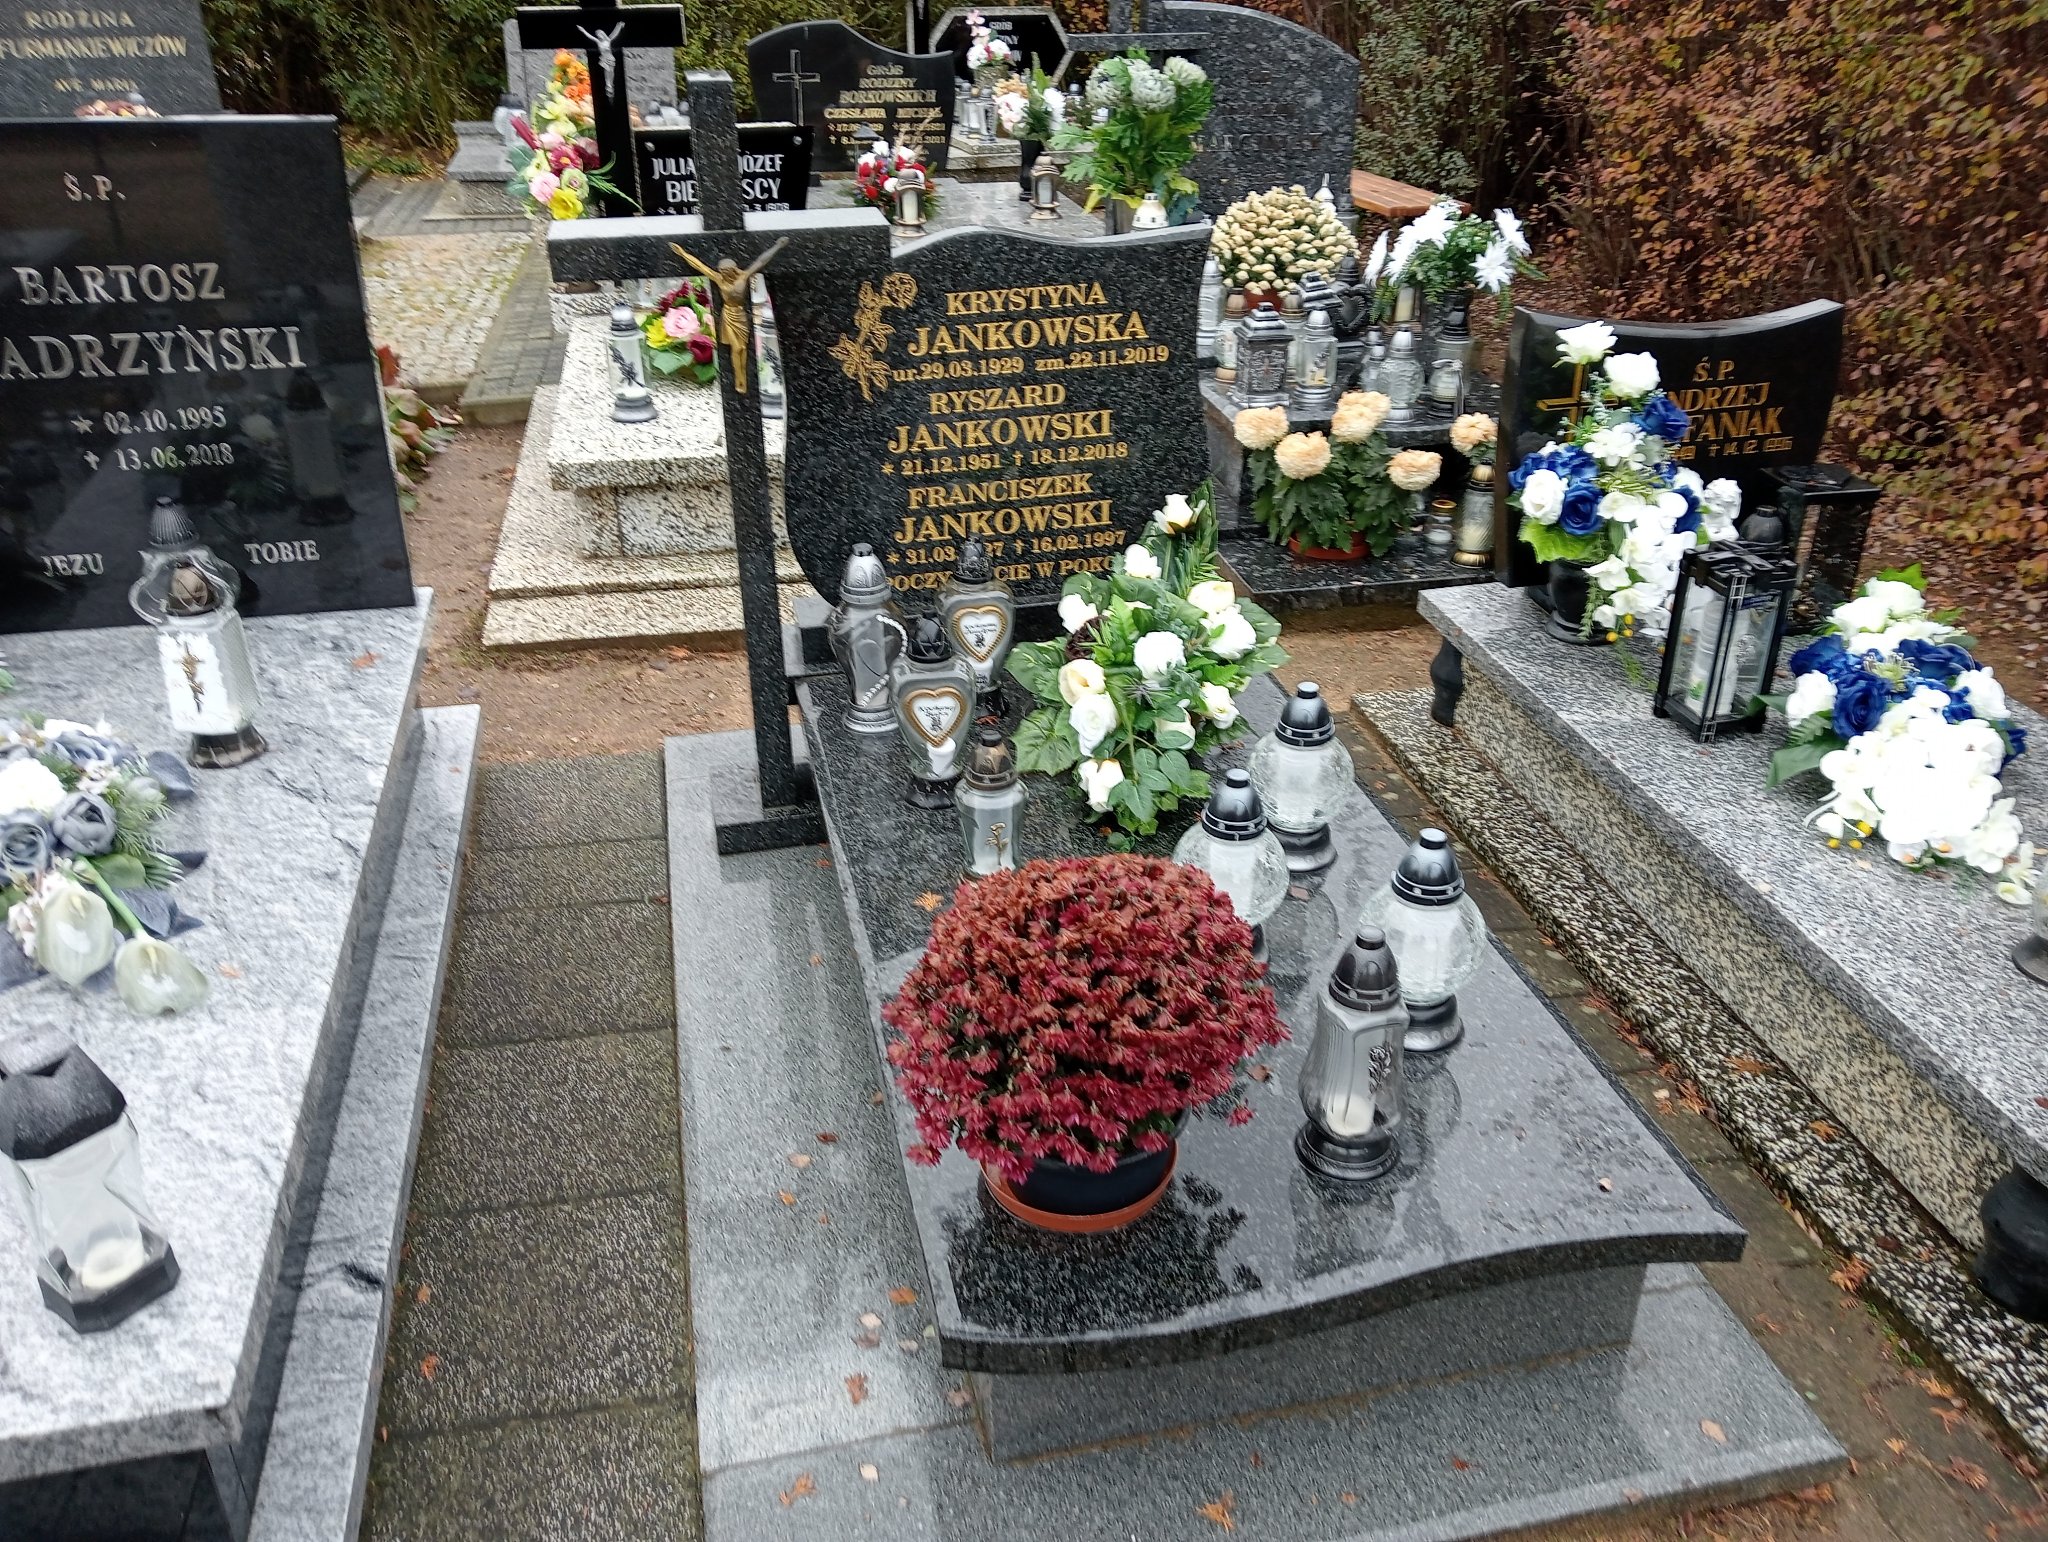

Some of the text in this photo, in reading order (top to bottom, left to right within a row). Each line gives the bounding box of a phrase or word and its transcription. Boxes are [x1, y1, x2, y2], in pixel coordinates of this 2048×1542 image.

[839, 89, 937, 103] BORKOWSKICH
[858, 77, 917, 89] RODZINY
[12, 262, 226, 306] BARTOSZ
[945, 282, 1108, 316] KRYSTYNA
[907, 311, 1150, 357] JANKOWSKA
[1034, 345, 1170, 372] zm.22.11.2019
[928, 383, 1067, 415] RYSZARD
[1667, 381, 1771, 413] NDRZEJ
[103, 405, 227, 435] 02.10.1995
[887, 410, 1114, 454] JANKOWSKI
[114, 442, 235, 471] 13.06.2018
[900, 441, 1129, 476] 21.12.1951 18.12.2018
[907, 473, 1093, 510] FRANCISZEK
[893, 500, 1114, 545] JANKOWSKI
[1031, 530, 1127, 554] 16.02.1997
[40, 539, 320, 578] JEZU TOBIE
[1035, 561, 1056, 579] W
